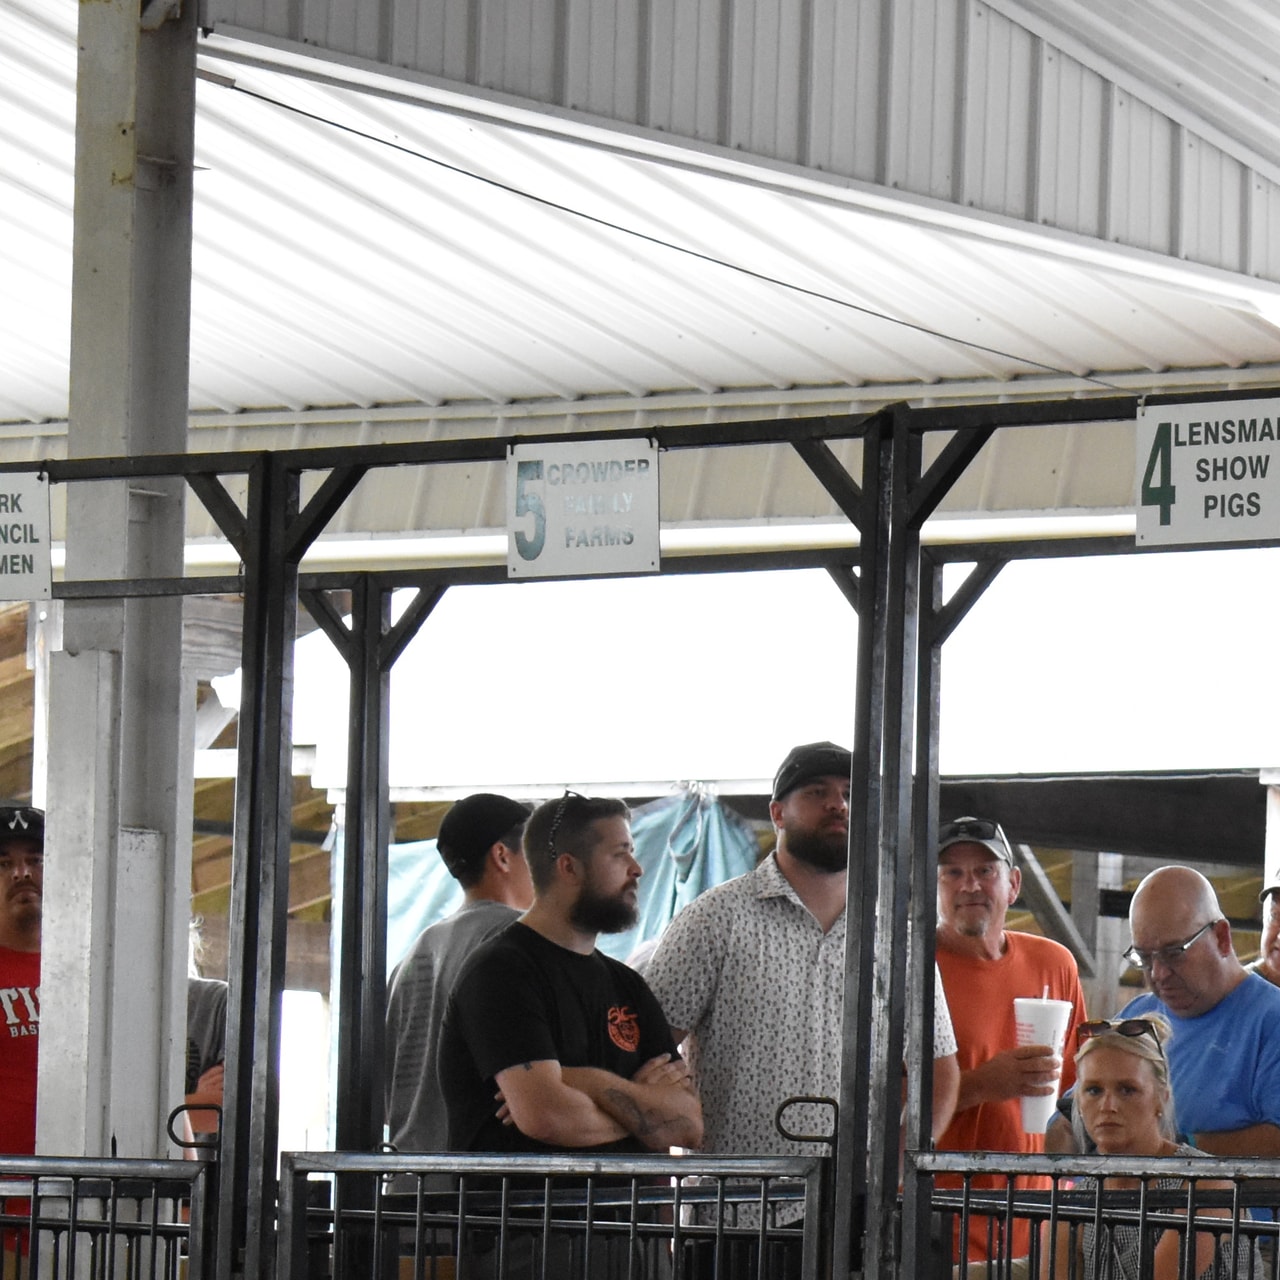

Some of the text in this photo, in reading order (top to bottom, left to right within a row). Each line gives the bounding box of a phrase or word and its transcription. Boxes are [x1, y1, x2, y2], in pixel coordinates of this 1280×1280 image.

[547, 459, 650, 486] CROWDER
[1141, 422, 1176, 526] 4
[1196, 455, 1270, 483] SHOW
[514, 460, 546, 561] 5
[1204, 492, 1261, 519] PIGS
[565, 526, 635, 549] FARMS
[0, 986, 40, 1024] TI
